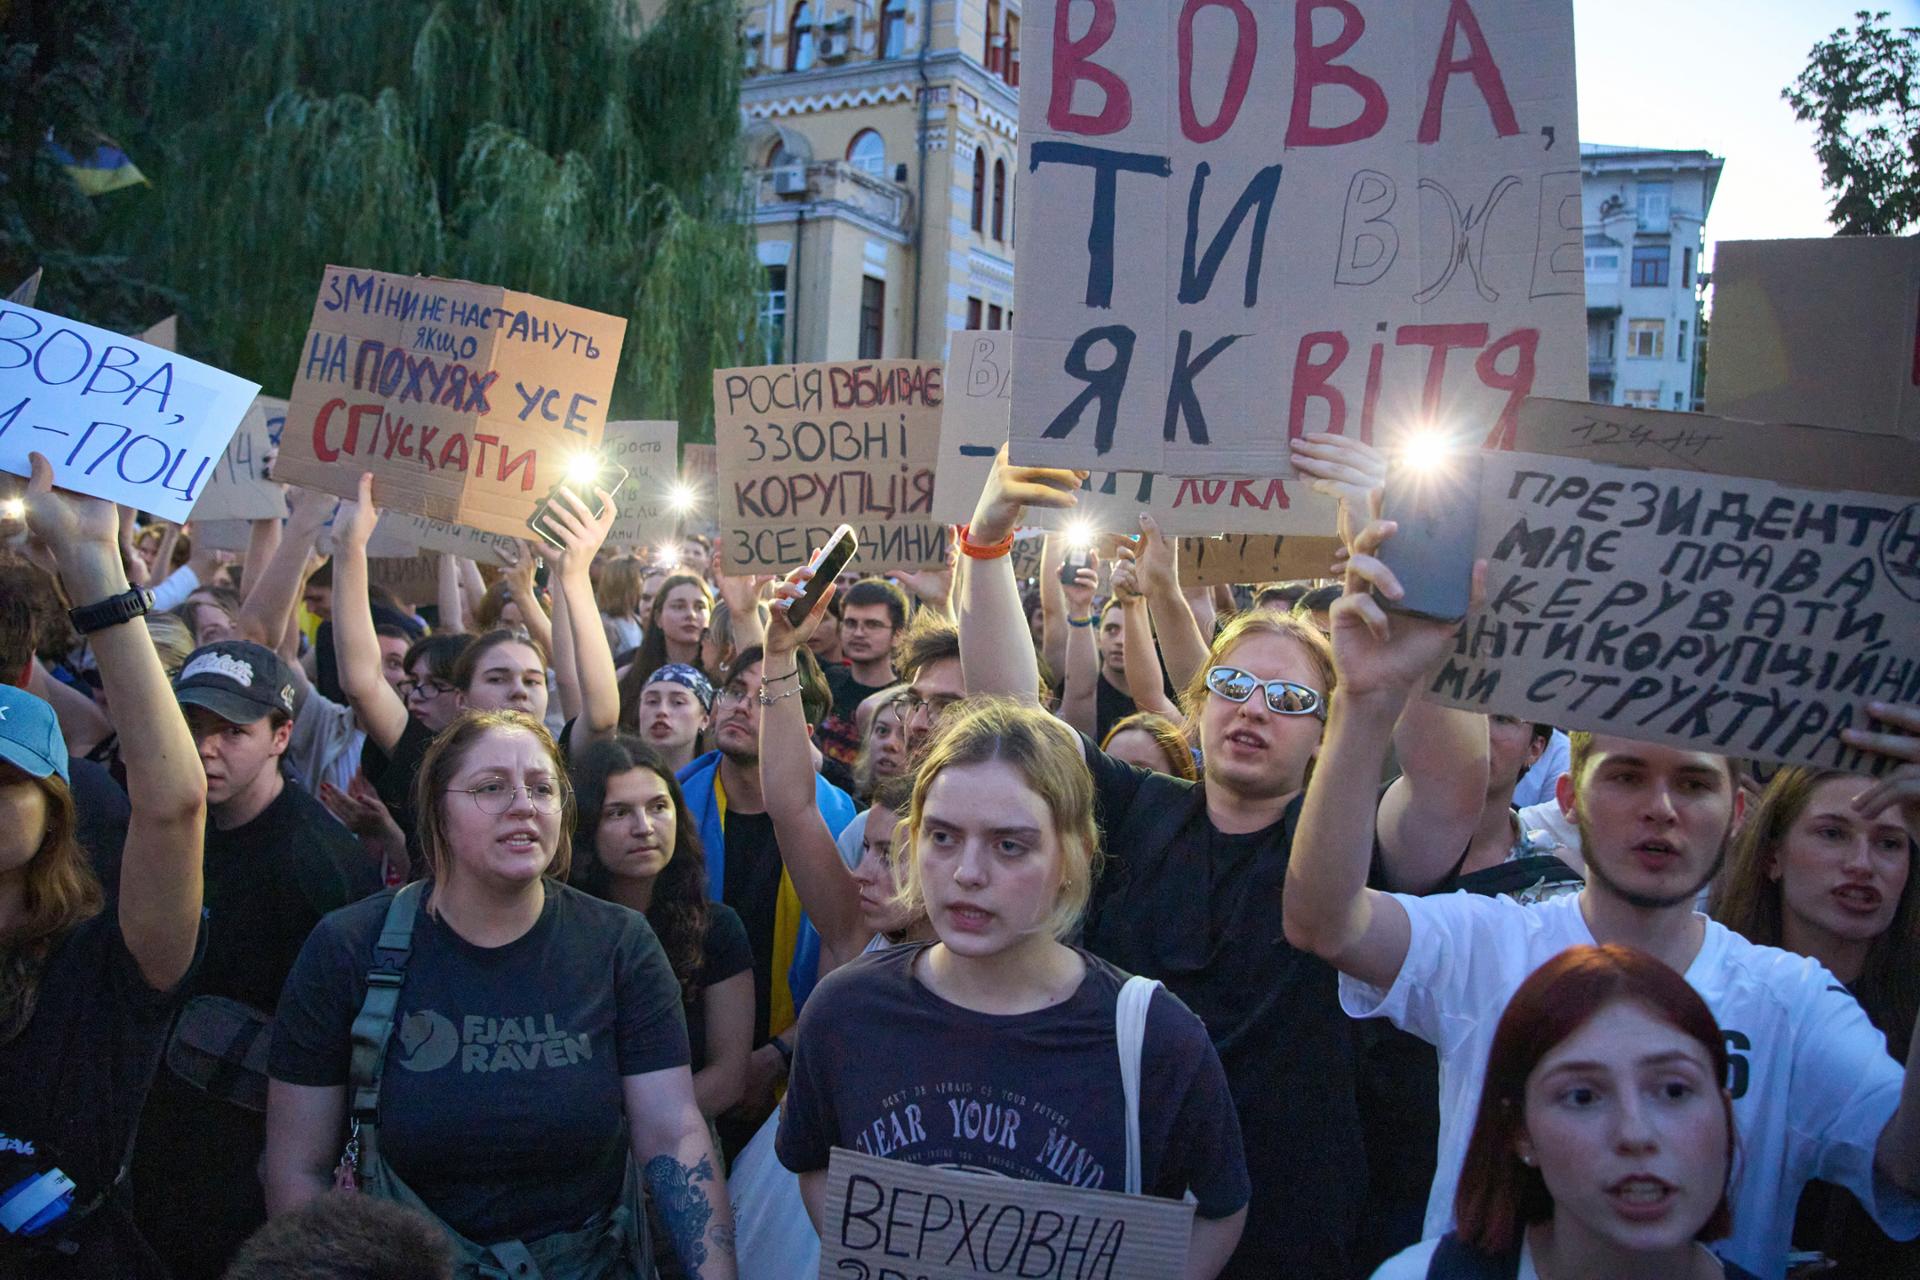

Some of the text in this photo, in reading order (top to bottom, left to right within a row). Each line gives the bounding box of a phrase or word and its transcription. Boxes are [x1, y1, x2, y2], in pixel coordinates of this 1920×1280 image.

[1047, 0, 1555, 150] ВОВА,
[1029, 140, 1586, 309] ТИ ВЖЕ
[413, 326, 477, 362] ЯКЩО
[420, 298, 447, 322] НЕ
[450, 300, 601, 360] НАСТАНУТЬ
[306, 332, 598, 436] НА ПОХУЯХ УСЕ
[828, 364, 943, 410] ВБИВАЄ
[1040, 324, 1257, 456] ЯК
[311, 397, 538, 492] СПУСКАТИ
[732, 523, 946, 566] ЗСЕРДИНИ
[1508, 470, 1897, 547] ПРЕЗИДЕНТ
[1492, 517, 1876, 611] МАЄ ПРАВА
[1491, 574, 1886, 643] КЕРУВАТИ
[1430, 657, 1501, 705] МИ
[948, 1097, 1021, 1150] YOUR
[841, 1174, 1126, 1280] ВЕРХОВНА
